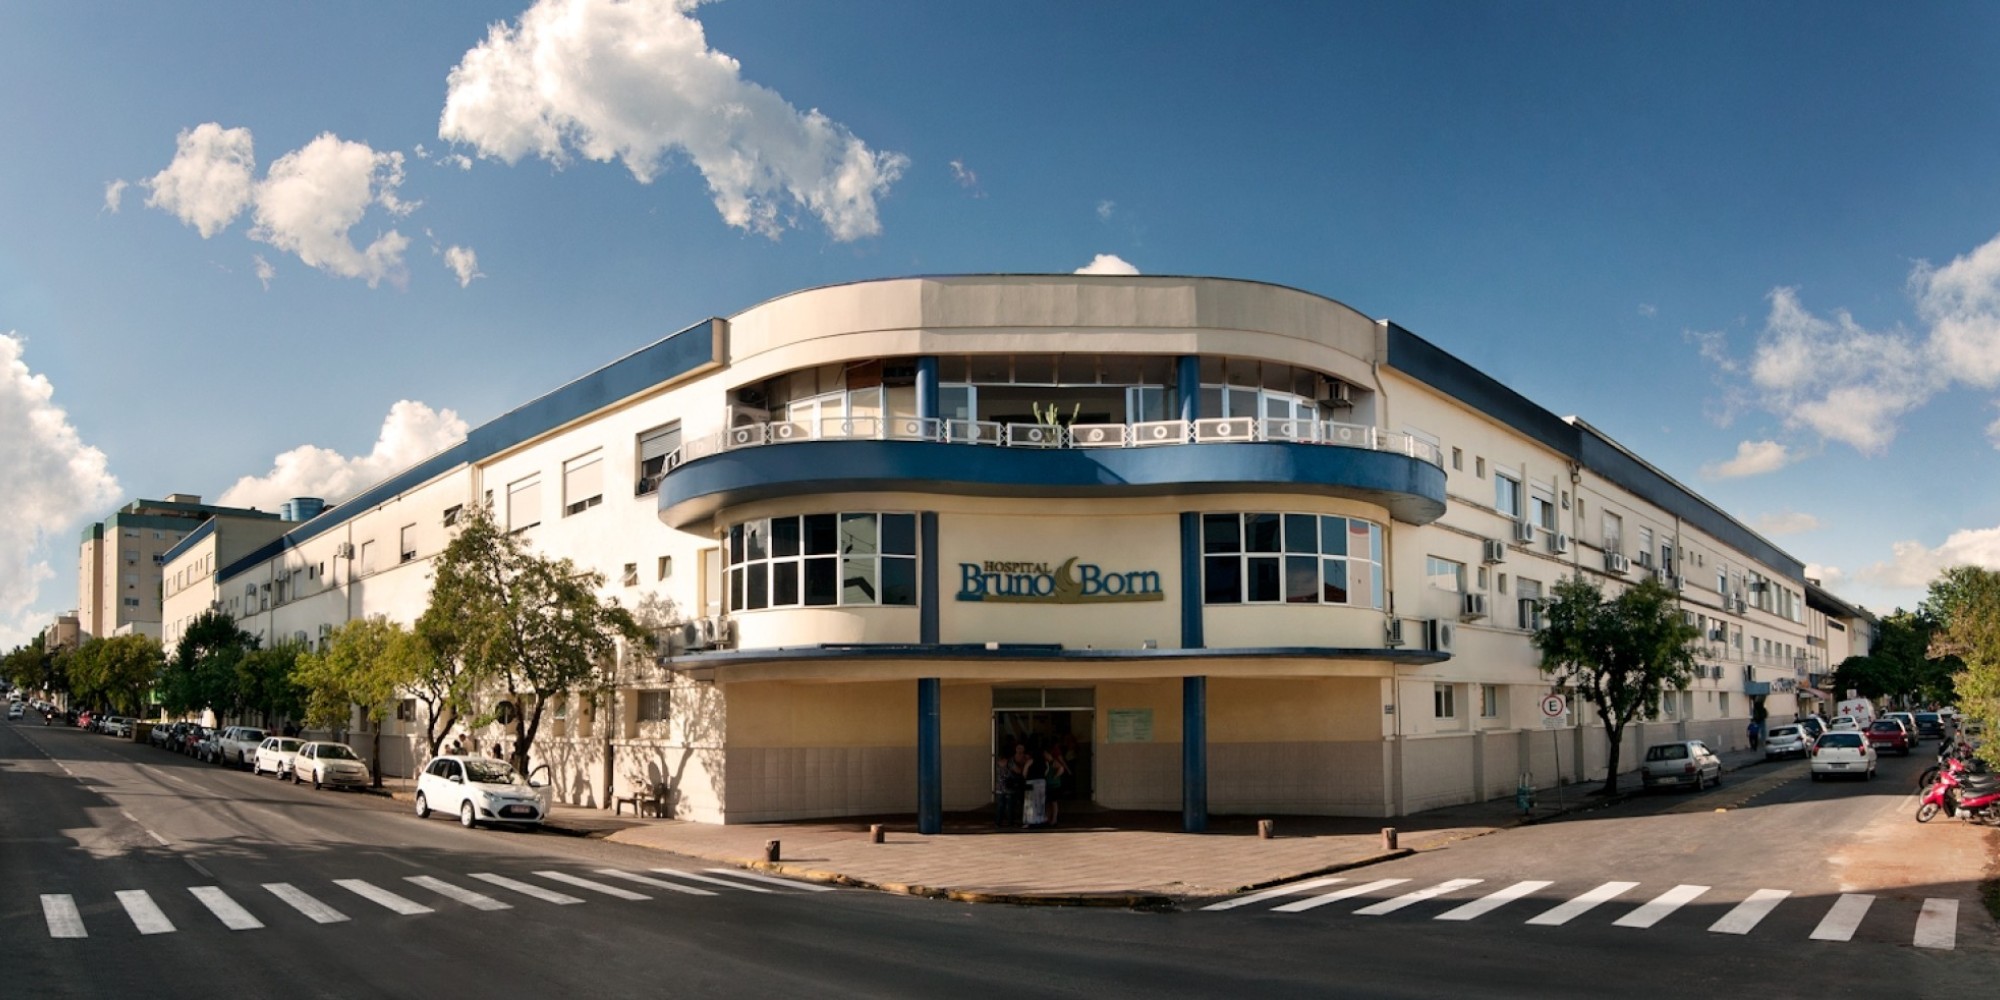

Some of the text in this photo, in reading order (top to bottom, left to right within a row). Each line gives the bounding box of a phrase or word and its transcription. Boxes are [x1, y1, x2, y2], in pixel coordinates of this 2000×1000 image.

[984, 561, 1053, 574] HOSPITAL
[959, 563, 1160, 596] Bruno Born
[1549, 700, 1557, 711] E
